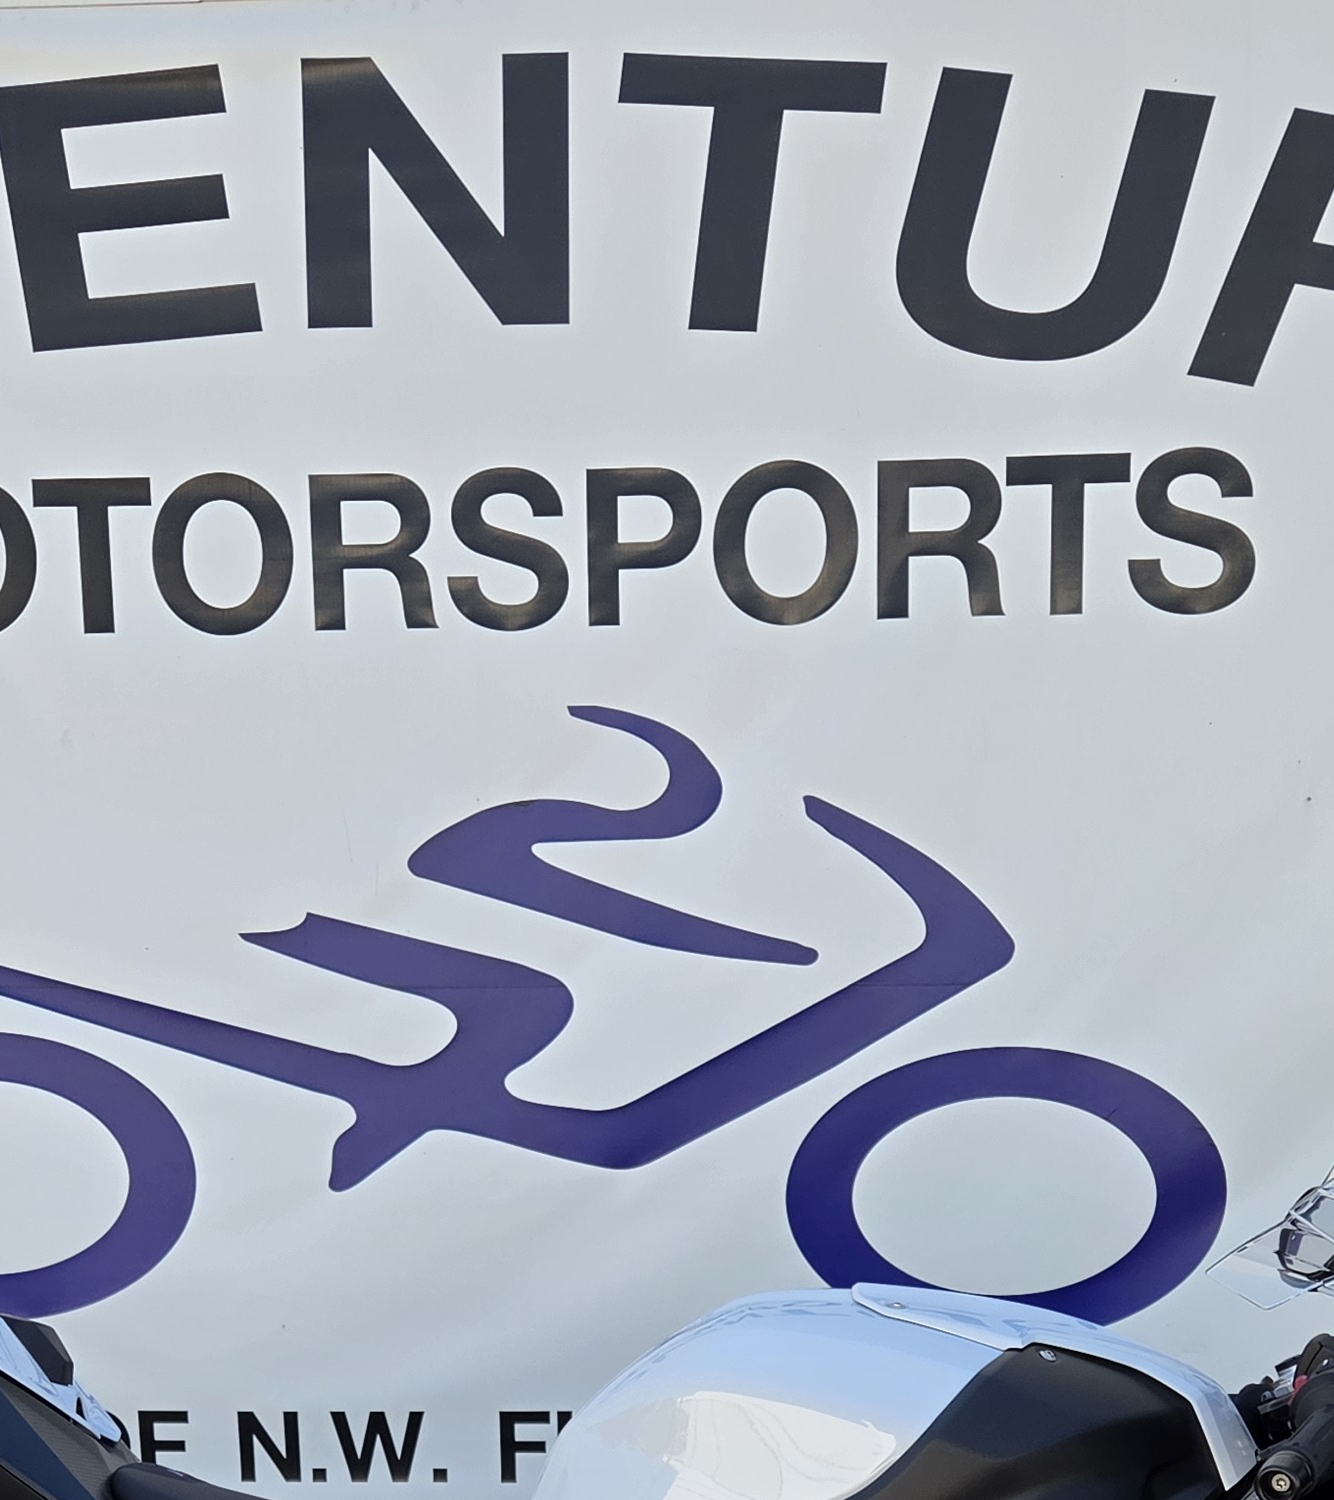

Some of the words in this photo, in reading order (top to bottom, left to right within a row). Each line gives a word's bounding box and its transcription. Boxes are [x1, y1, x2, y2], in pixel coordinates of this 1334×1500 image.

[105, 1410, 189, 1464] F
[237, 1410, 448, 1483] N.W.
[499, 1410, 573, 1483] F
